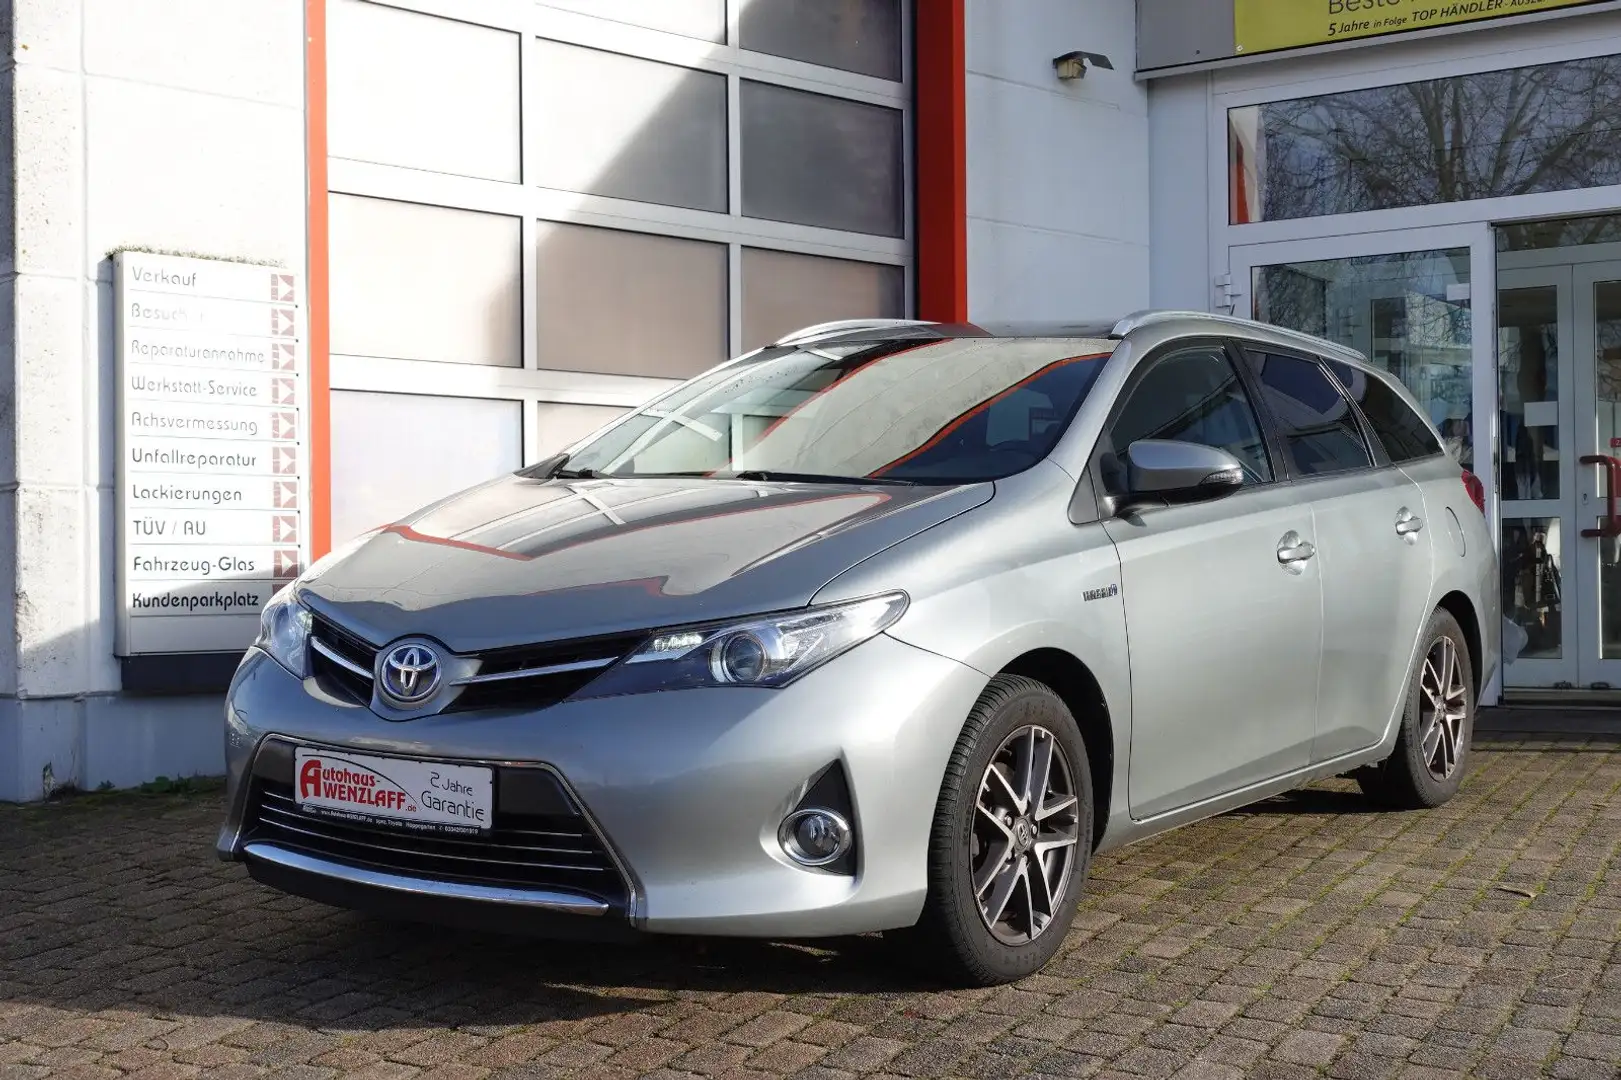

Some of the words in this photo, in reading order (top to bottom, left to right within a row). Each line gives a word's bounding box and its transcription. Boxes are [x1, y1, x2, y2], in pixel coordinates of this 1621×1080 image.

[1327, 22, 1337, 37] 5
[1338, 20, 1370, 34] Jahre
[1373, 19, 1382, 28] in
[1383, 16, 1408, 27] Folge
[1411, 8, 1438, 22] TOP
[132, 265, 197, 288] Verkauf
[131, 339, 266, 364] Reparaturannahme
[131, 375, 259, 398] Werkstatt-Service
[131, 411, 259, 436] Achsvermessung
[132, 447, 257, 469] Unfallreparatur
[132, 484, 243, 505] Lackierungen
[133, 516, 167, 536] TÜV
[183, 520, 207, 536] AU
[133, 556, 256, 576] Fahrzeug-Glas
[132, 591, 260, 612] Kundenparkplatz
[430, 771, 440, 788] 2
[441, 778, 473, 797] Jahre
[421, 790, 485, 822] Garantie
